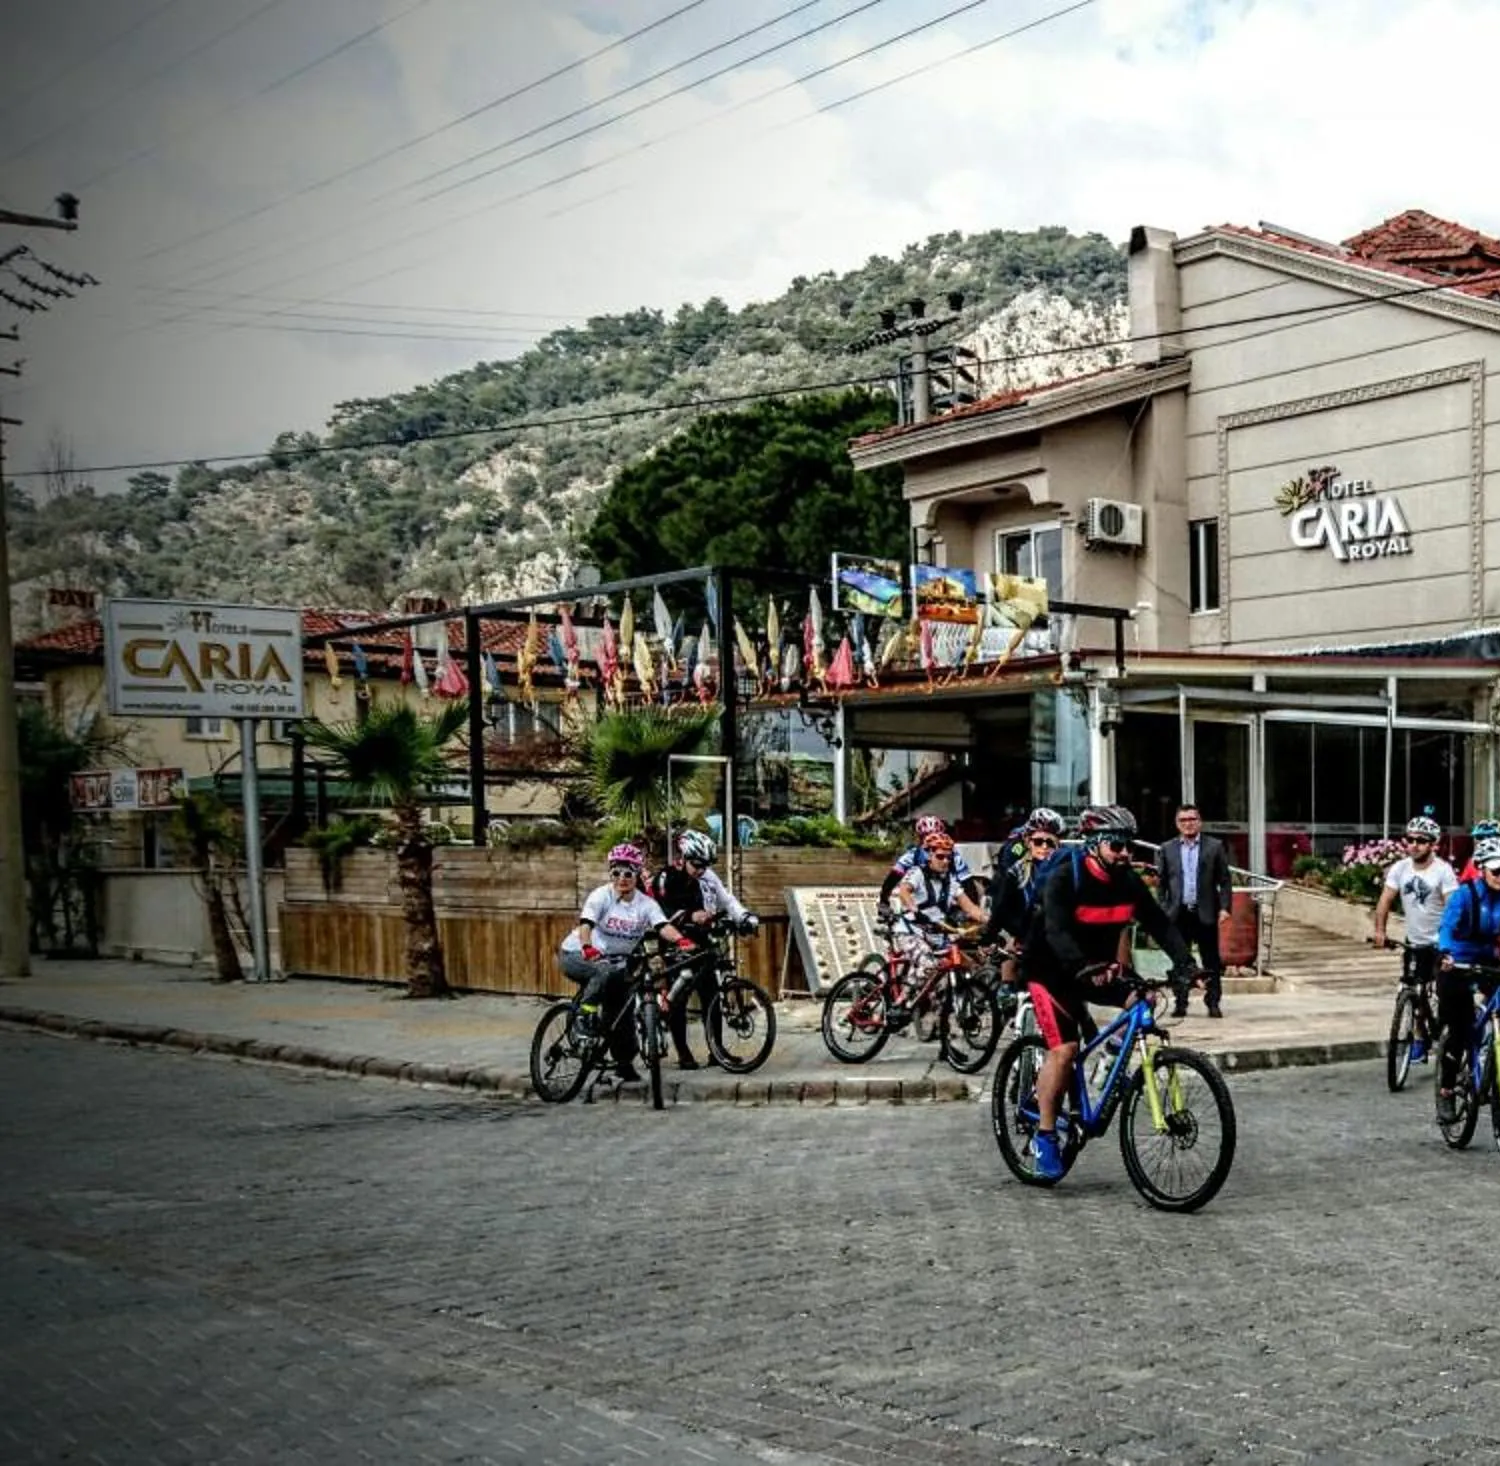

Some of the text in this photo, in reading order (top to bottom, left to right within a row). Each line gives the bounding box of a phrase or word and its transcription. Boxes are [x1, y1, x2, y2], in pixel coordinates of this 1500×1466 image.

[1291, 497, 1409, 560] CARIA
[1349, 537, 1410, 560] ROYAL
[122, 637, 292, 693] CARIA
[213, 683, 295, 697] ROYAL
